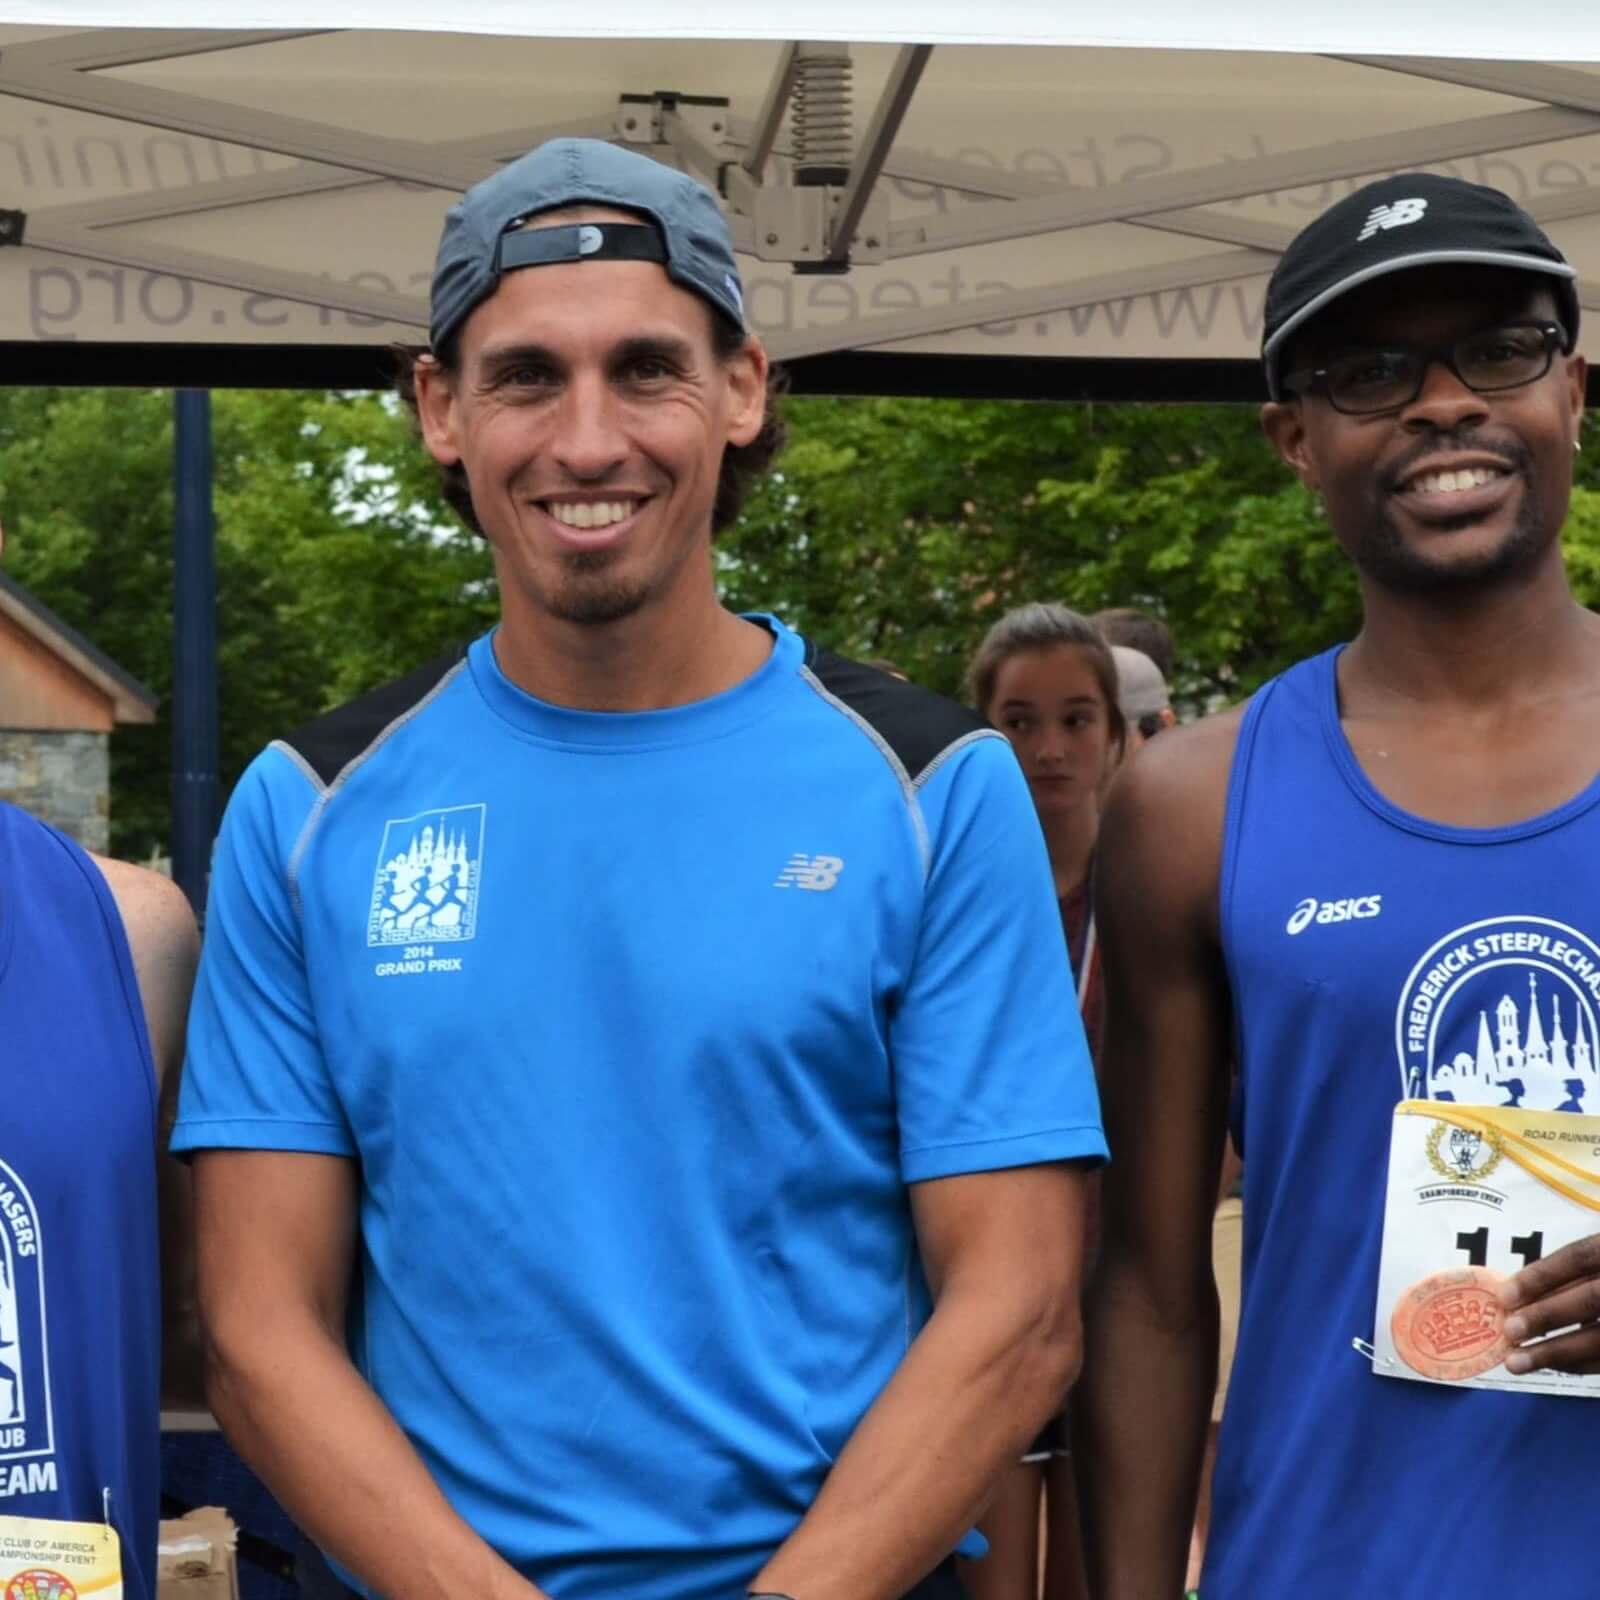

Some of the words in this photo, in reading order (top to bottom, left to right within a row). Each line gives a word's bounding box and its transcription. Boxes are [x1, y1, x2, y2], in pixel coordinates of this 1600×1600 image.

[1316, 895, 1382, 924] asics
[403, 946, 435, 960] 2014
[375, 960, 426, 977] GRAND
[427, 958, 463, 972] PRIX
[1408, 943, 1476, 1052] FREDERICK
[1451, 1129, 1483, 1144] RRCA
[1523, 1129, 1557, 1141] ROAD
[4, 1537, 32, 1549] CLUB
[34, 1540, 48, 1550] OF
[50, 1542, 96, 1553] AMERICA
[64, 1554, 97, 1566] EVENT
